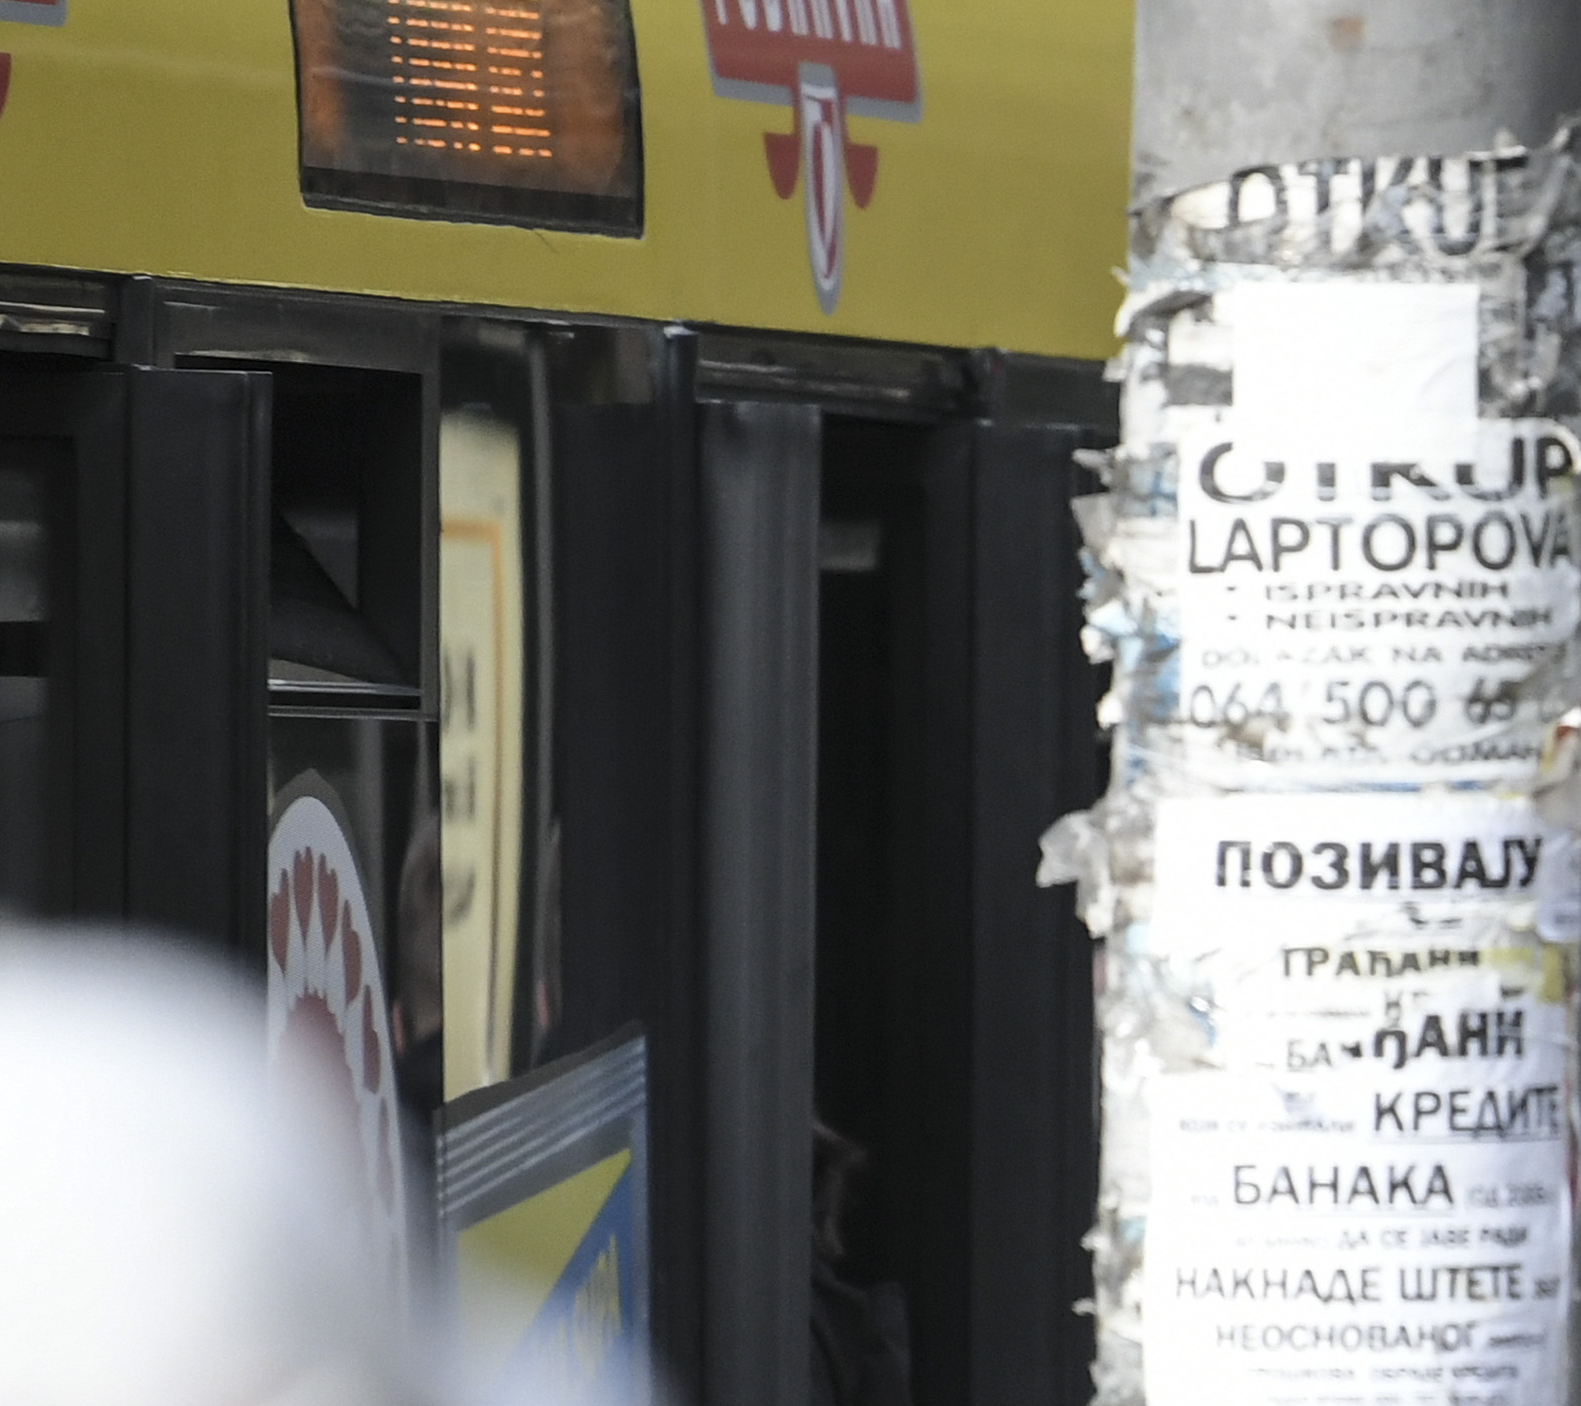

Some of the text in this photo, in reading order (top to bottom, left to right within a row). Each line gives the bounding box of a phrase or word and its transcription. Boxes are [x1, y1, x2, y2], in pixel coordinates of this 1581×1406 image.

[1187, 514, 1572, 574] LAPTOPOVA
[1322, 680, 1437, 728] 500
[1216, 839, 1542, 890] ПОЗИВАЈУ
[1234, 1163, 1455, 1205] БАНАКА
[1176, 1267, 1382, 1305] НАКНАДЕ
[1400, 1262, 1522, 1301] ШТЕТЕ
